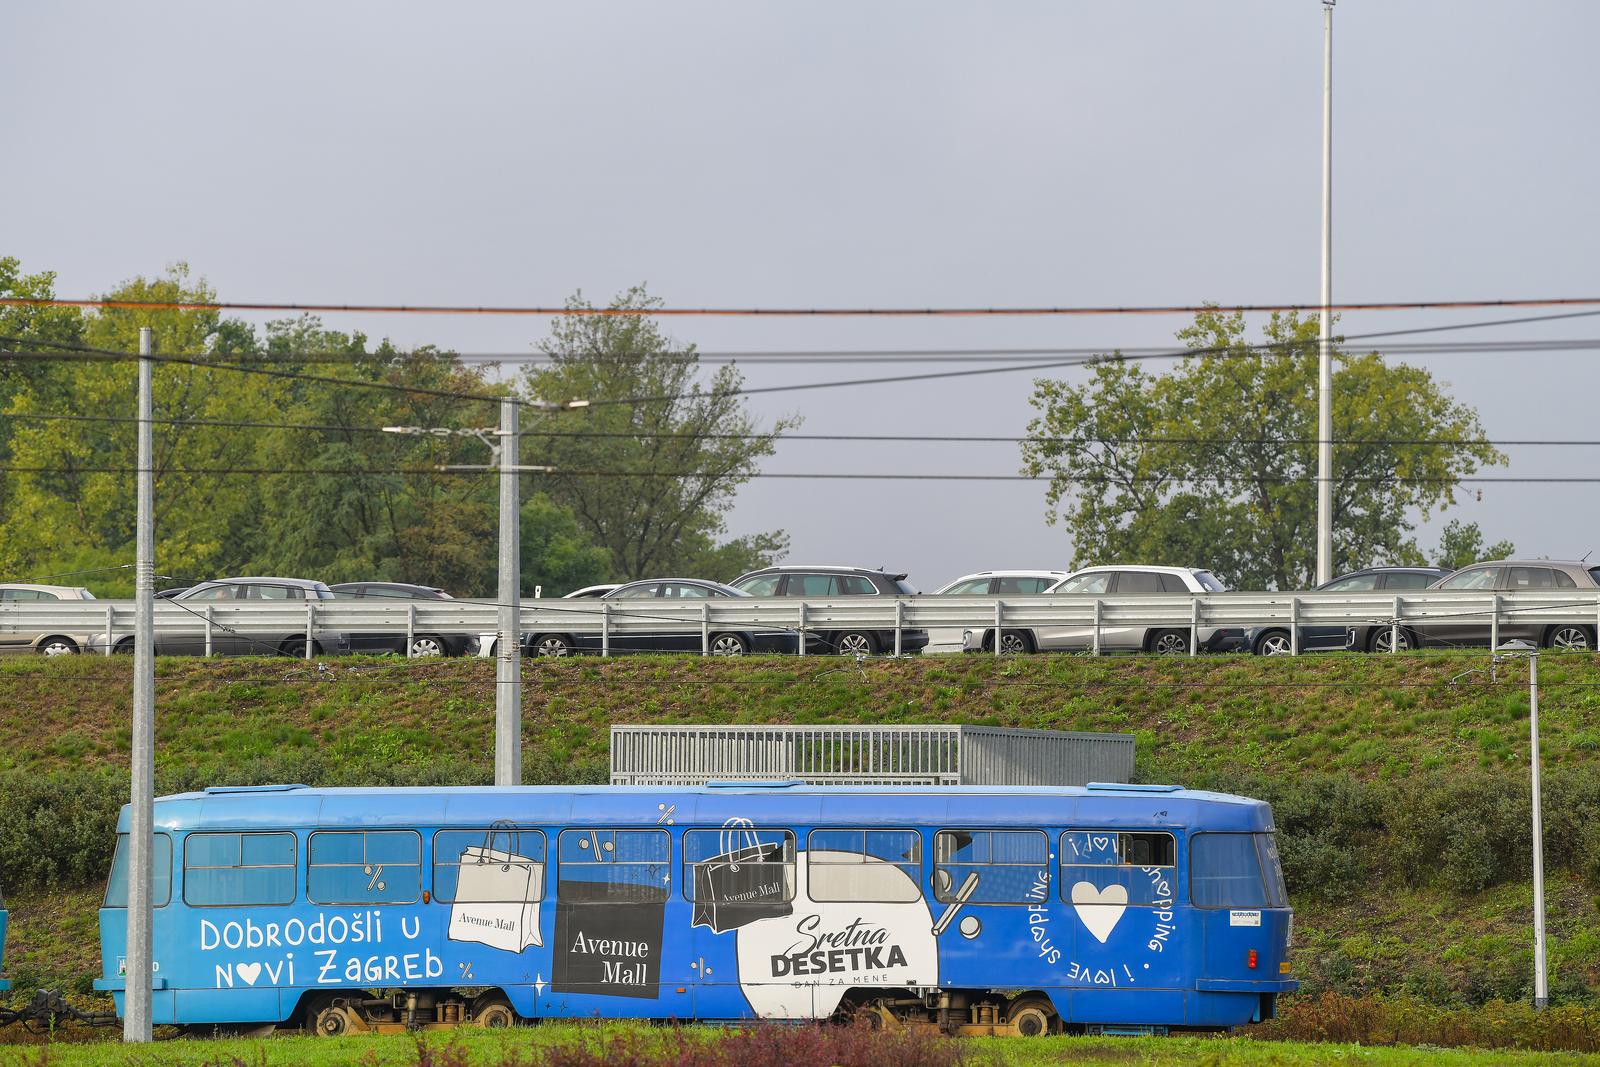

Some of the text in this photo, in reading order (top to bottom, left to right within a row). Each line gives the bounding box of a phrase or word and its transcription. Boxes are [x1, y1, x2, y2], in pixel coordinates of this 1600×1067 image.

[759, 882, 780, 897] Mall
[459, 912, 515, 931] Avenue Mall
[570, 931, 649, 958] Avenue
[784, 914, 890, 962] Sretna
[601, 961, 647, 986] Mall
[770, 945, 908, 977] DESETKA
[853, 974, 888, 983] MENE
